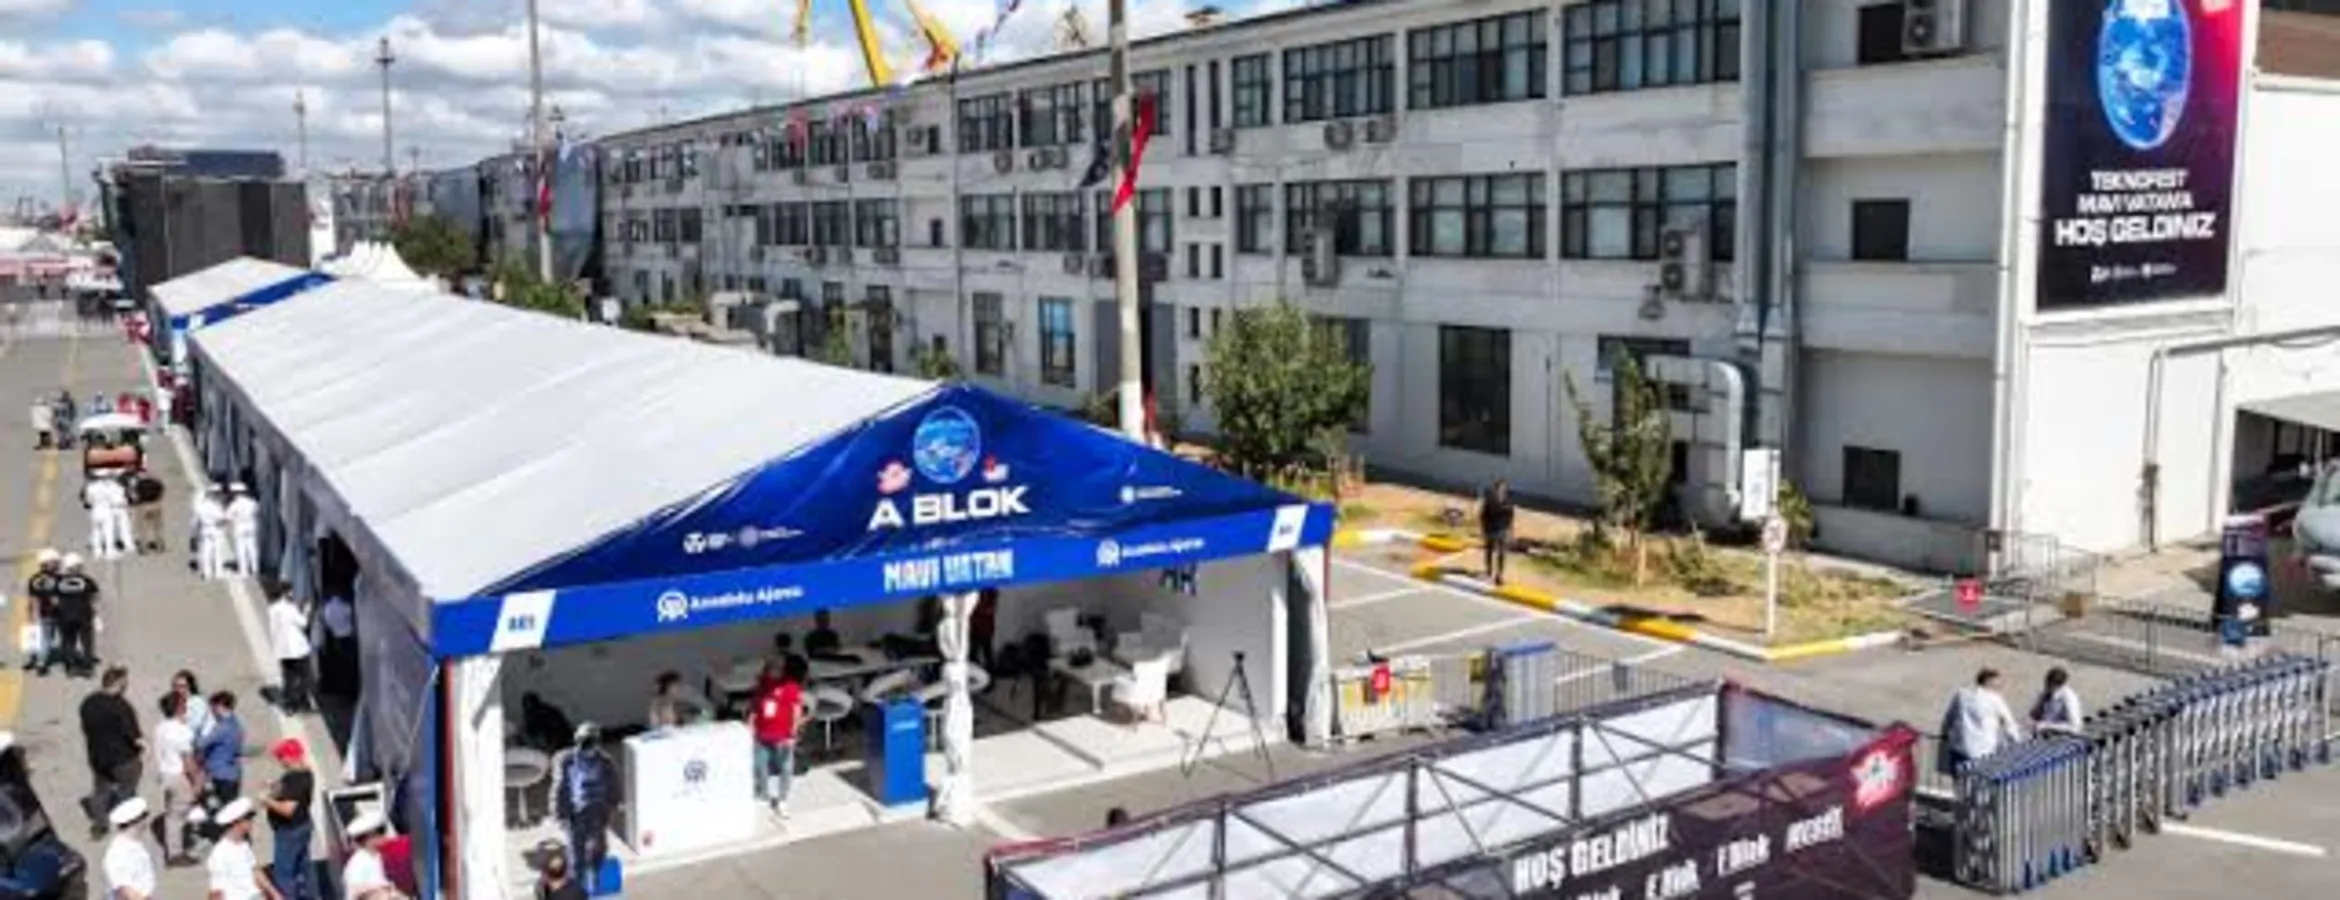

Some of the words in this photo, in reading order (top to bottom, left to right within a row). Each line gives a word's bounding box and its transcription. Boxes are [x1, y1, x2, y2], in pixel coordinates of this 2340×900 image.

[2090, 168, 2189, 191] TEKNOFEST
[2054, 218, 2107, 247] HOŞ
[867, 497, 905, 532] A
[912, 484, 1032, 527] BLOK
[1513, 844, 1566, 895] HOŞ
